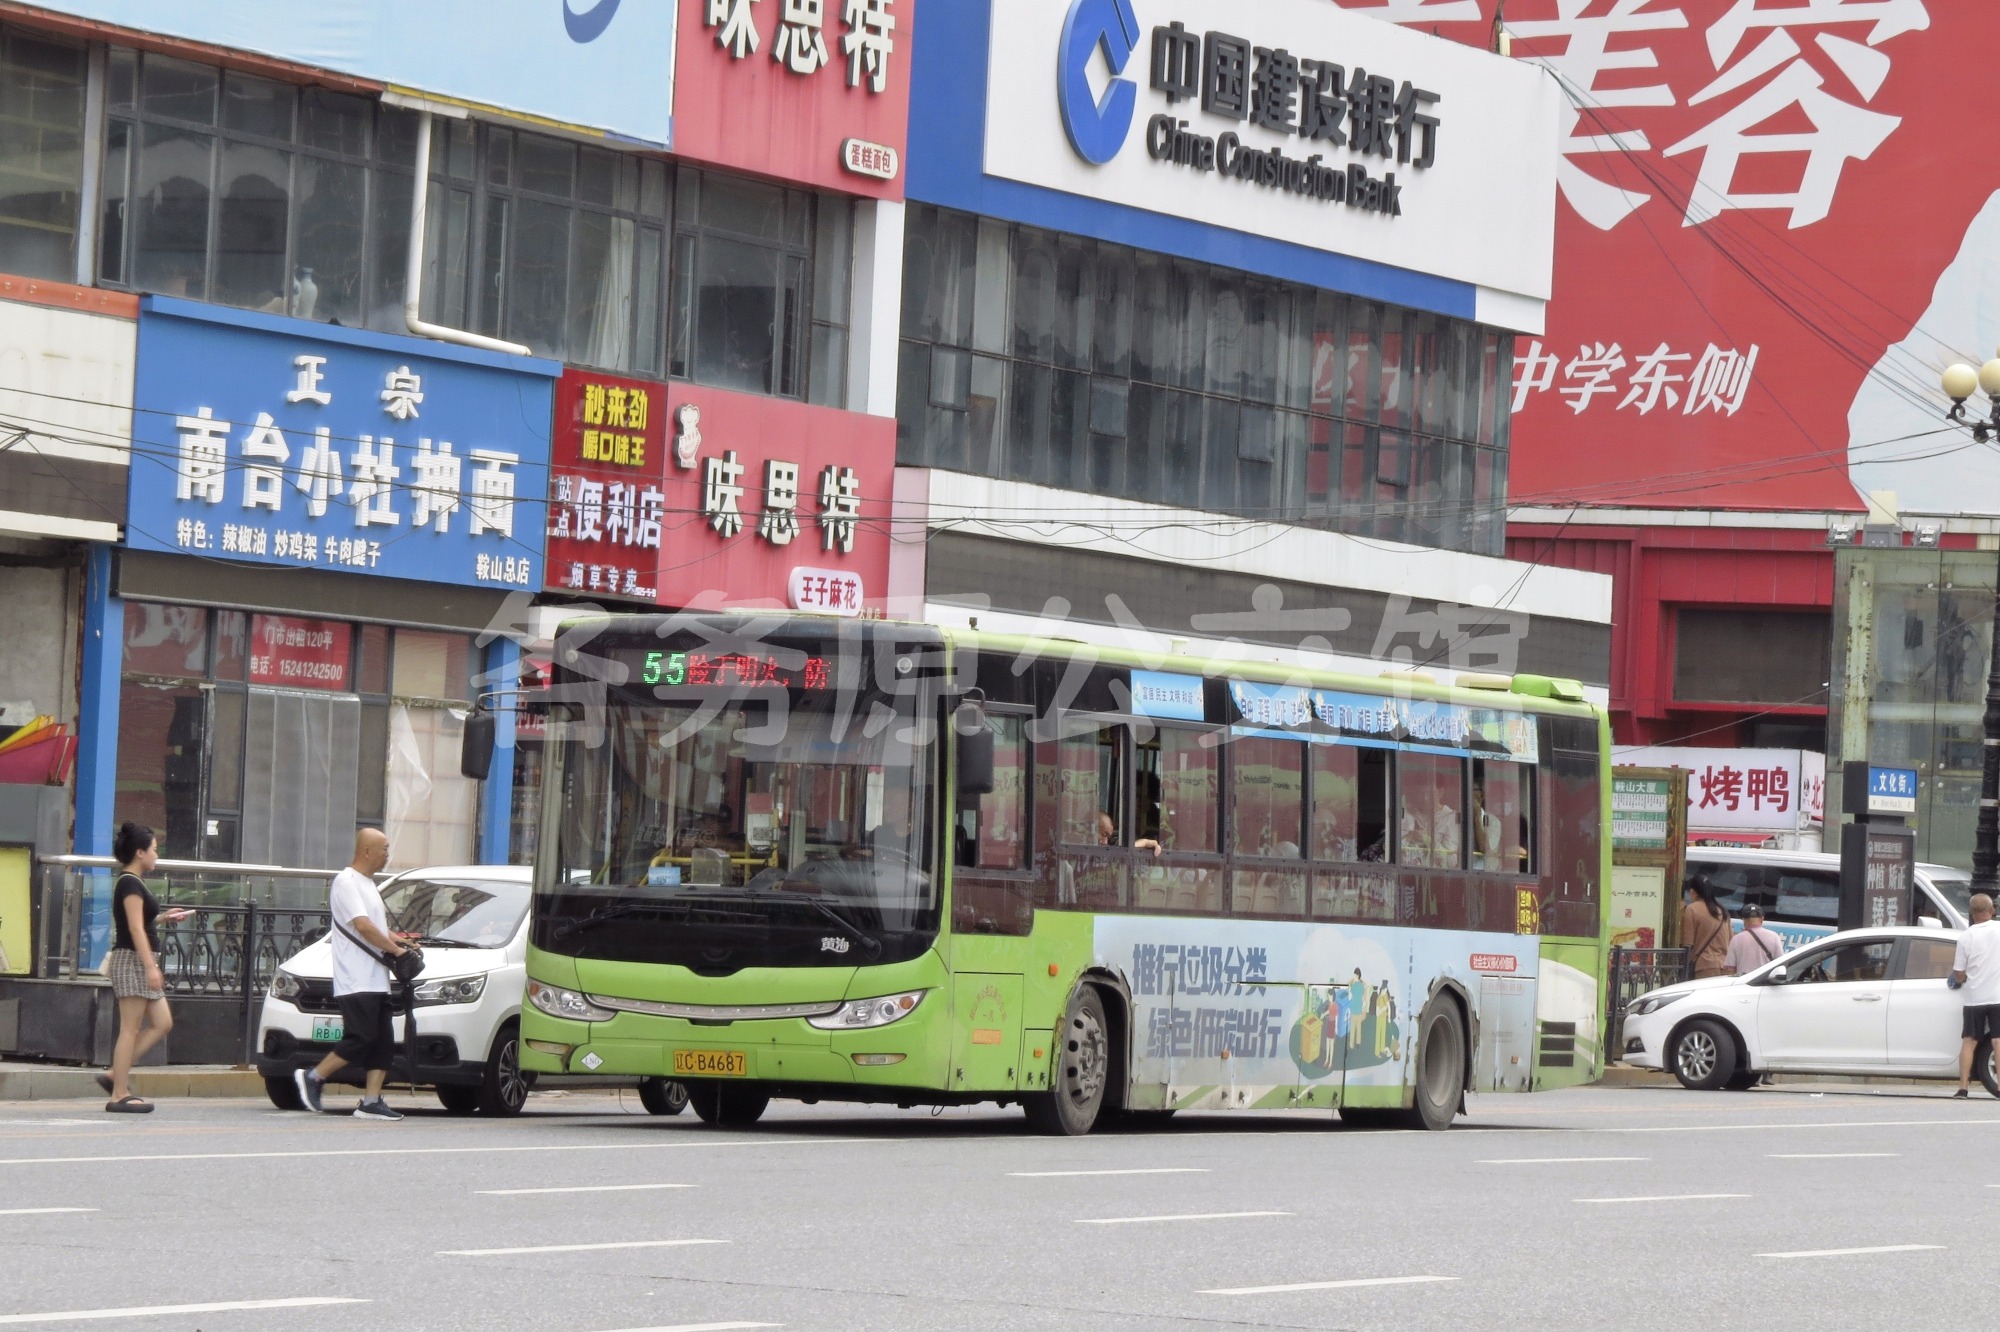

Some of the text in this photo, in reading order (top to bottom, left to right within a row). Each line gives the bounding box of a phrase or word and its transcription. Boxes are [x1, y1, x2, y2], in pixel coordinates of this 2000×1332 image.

[1150, 21, 1440, 168] 中国建设银行
[851, 144, 891, 173] 蛋糕面包
[1147, 113, 1402, 216] China Construction Bank
[287, 355, 424, 419] 正宗
[581, 429, 646, 466] 嚼口味王
[574, 475, 665, 549] 便利店
[699, 450, 861, 553] 味思特
[222, 523, 266, 555] 辣椒油
[274, 529, 317, 560] 炒鸡架
[475, 553, 530, 584] 鞍山总店
[570, 562, 637, 593] 烟草专卖
[801, 576, 857, 609] 王子麻花
[265, 625, 333, 650] 门市出租120平
[280, 659, 342, 681] 15241242500
[643, 651, 686, 685] 55
[1615, 781, 1656, 794] 鞍山大厦
[1879, 772, 1907, 794] 文化街
[820, 936, 849, 953] 黄海
[1132, 943, 1267, 996] 推行垃圾分类
[1146, 1007, 1282, 1058] 绿色低碳出行
